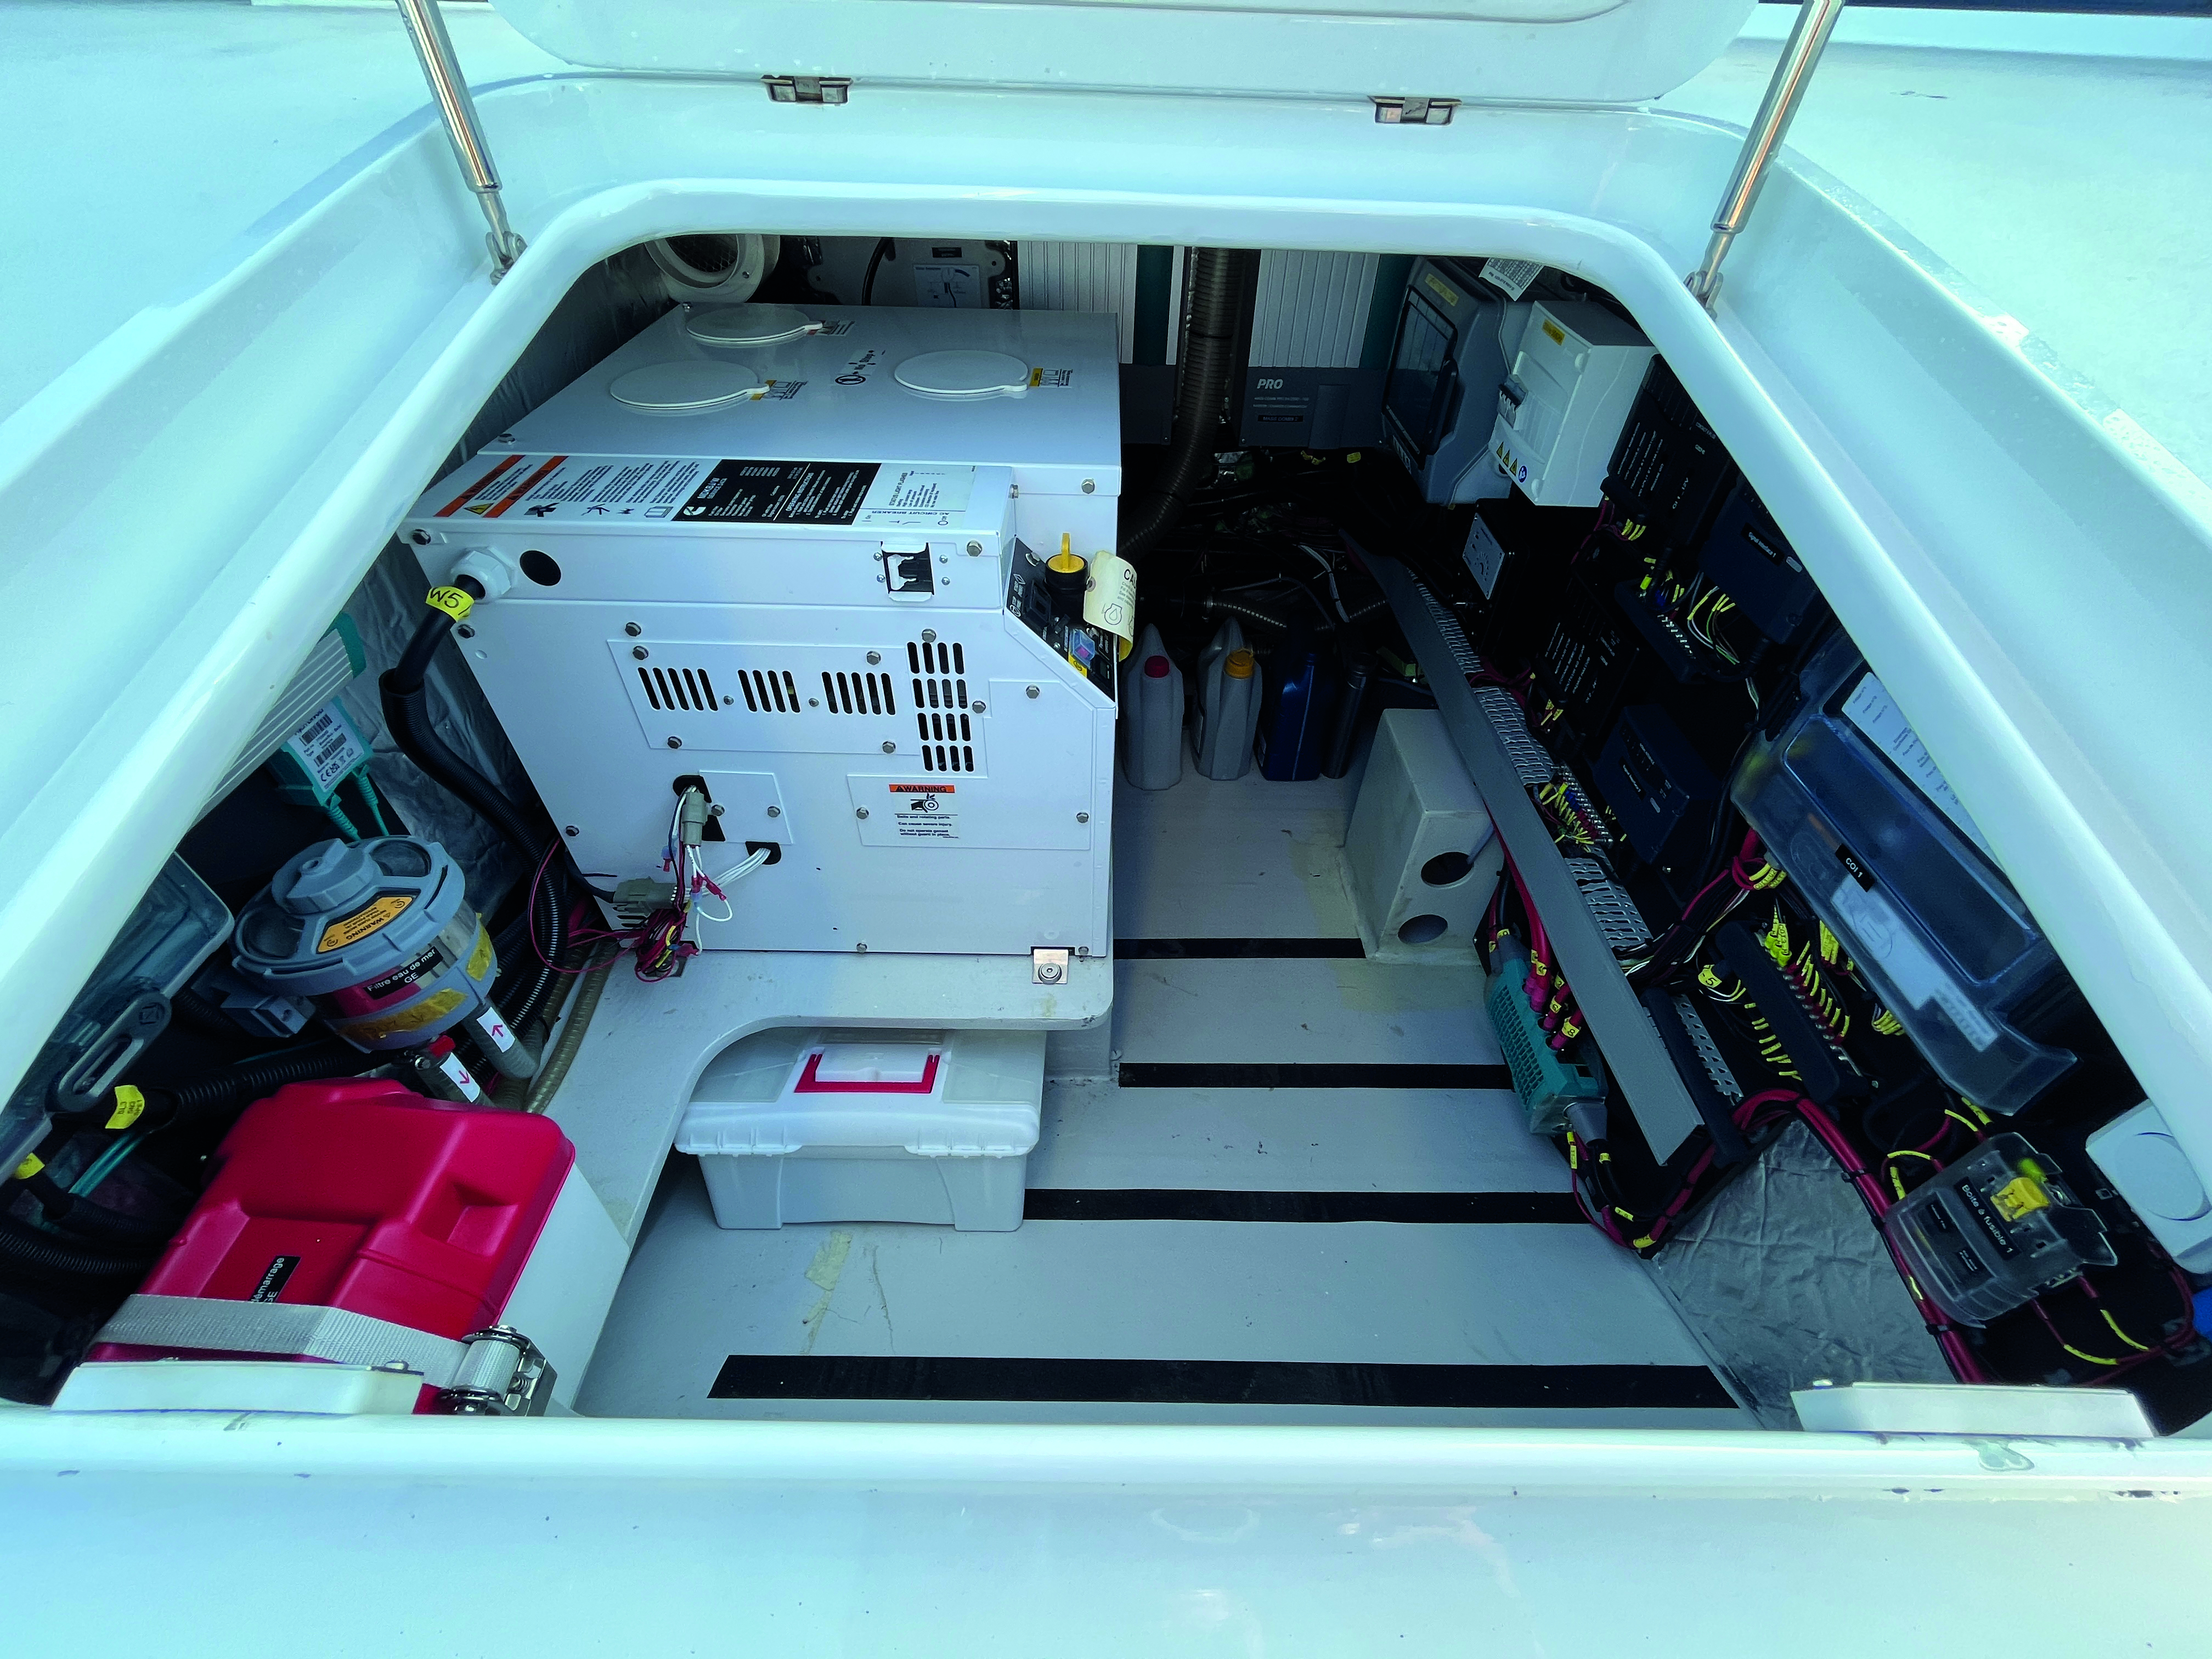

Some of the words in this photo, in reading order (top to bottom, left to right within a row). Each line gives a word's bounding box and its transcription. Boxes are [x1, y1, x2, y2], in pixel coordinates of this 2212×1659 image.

[1256, 379, 1283, 389] PRO
[1846, 857, 1858, 872] COI
[346, 918, 384, 940] WARNING
[367, 979, 391, 991] Filtre
[392, 969, 409, 980] eau
[410, 962, 421, 970] de
[421, 949, 436, 963] mer
[404, 972, 419, 984] GE
[1984, 1216, 2006, 1245] fusible
